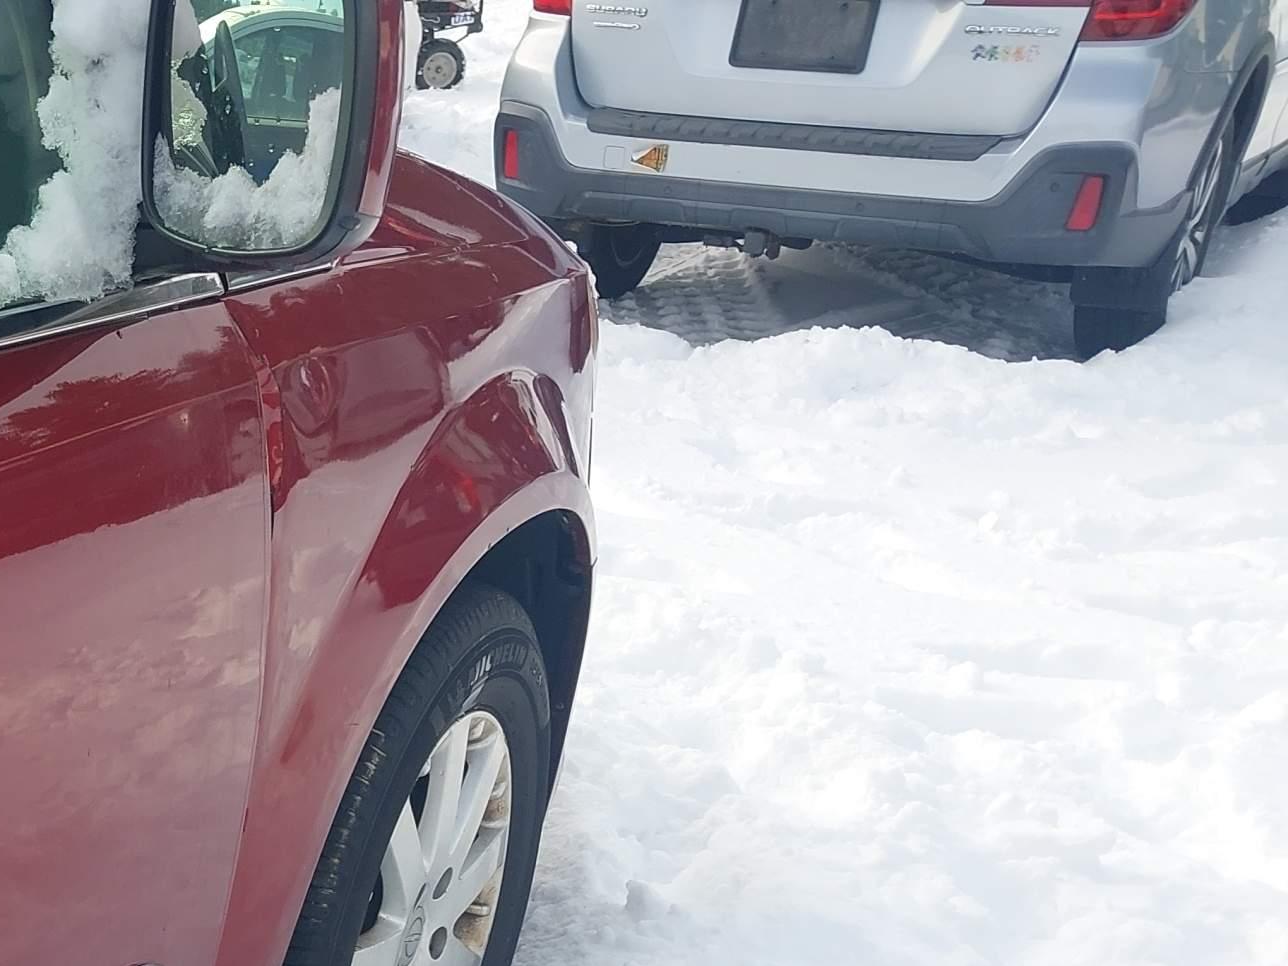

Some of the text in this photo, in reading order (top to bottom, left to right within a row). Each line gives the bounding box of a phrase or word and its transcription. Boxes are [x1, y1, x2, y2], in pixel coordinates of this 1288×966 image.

[585, 3, 649, 17] SUBARU
[964, 24, 1062, 37] OUTBACK
[469, 642, 529, 686] MICHELIN
